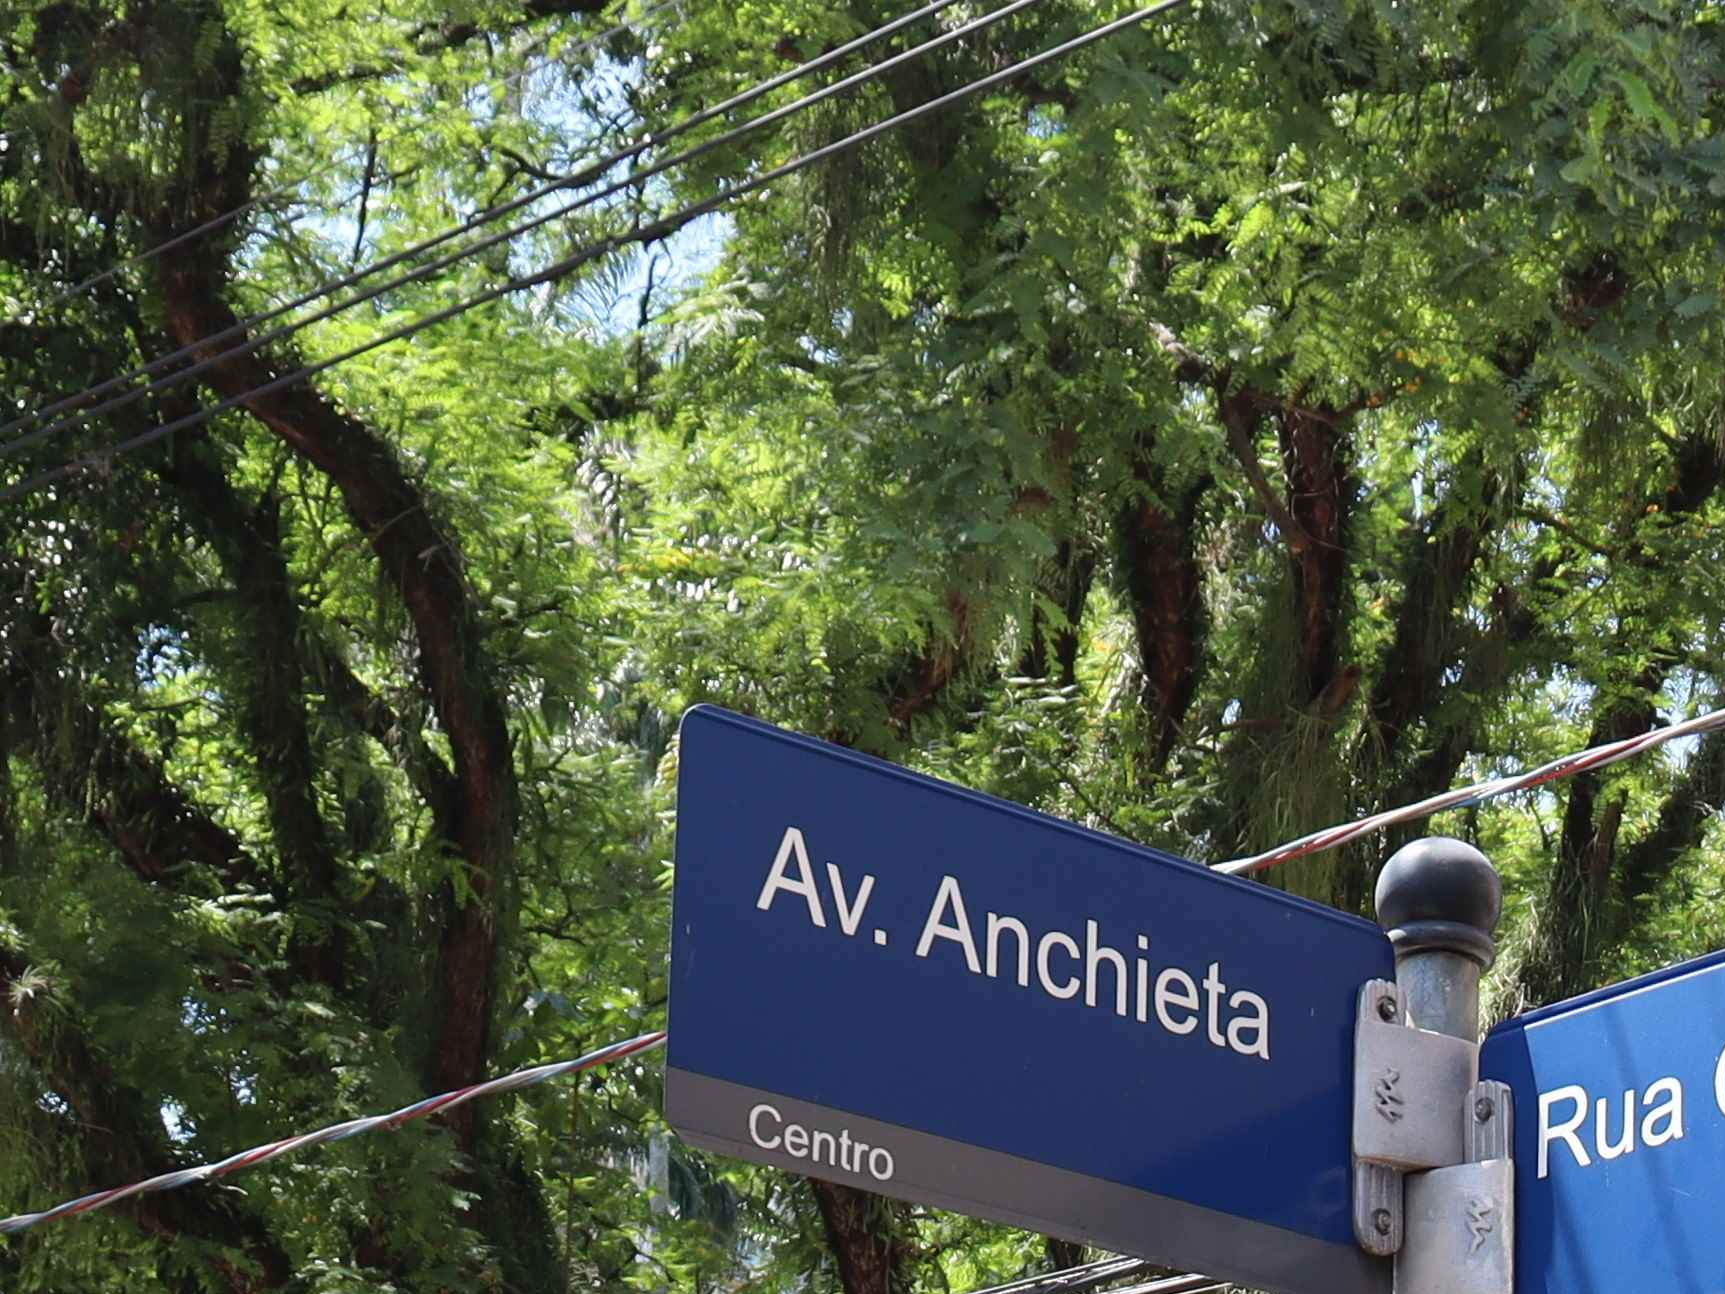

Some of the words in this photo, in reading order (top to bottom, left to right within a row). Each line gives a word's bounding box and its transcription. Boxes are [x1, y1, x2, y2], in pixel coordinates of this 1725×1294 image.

[756, 826, 888, 946] Av.
[915, 875, 1271, 1060] Anchieta
[748, 1103, 895, 1182] Centro
[1536, 1076, 1684, 1178] Rua
